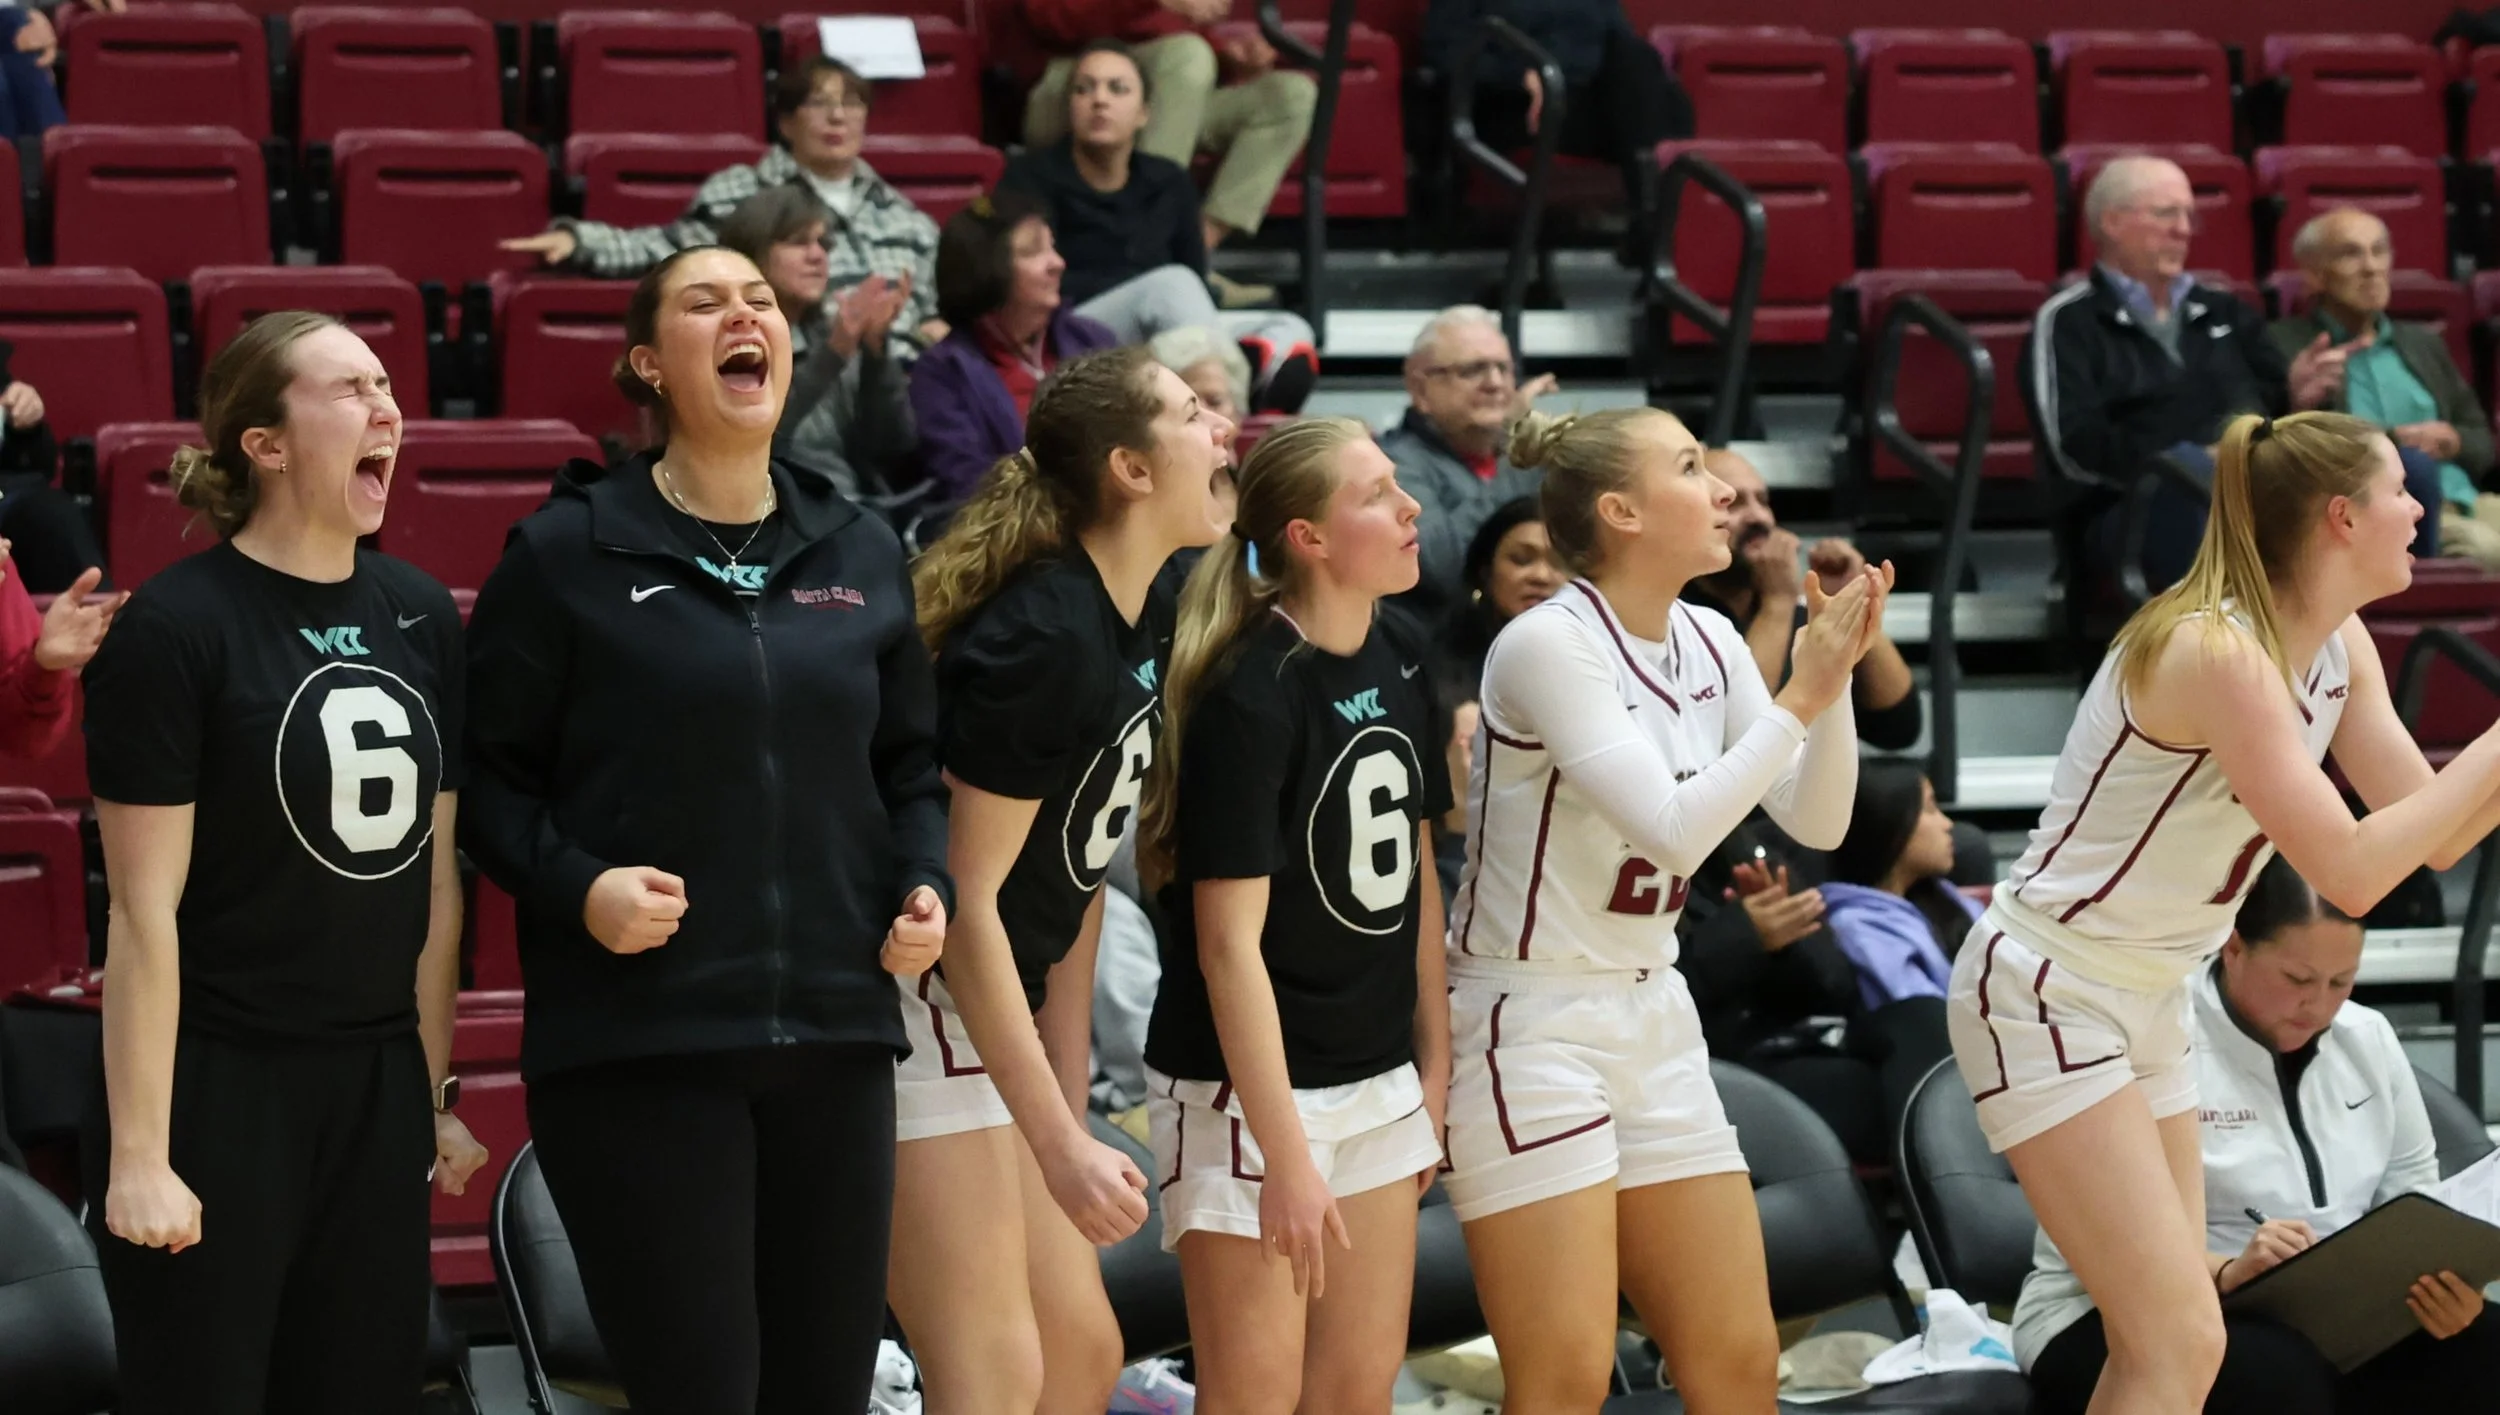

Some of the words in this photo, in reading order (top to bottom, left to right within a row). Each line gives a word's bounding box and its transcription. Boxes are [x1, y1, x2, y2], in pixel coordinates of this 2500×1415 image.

[696, 556, 769, 589] WCC
[300, 627, 371, 656] WCC
[1334, 687, 1387, 725] WCC
[1689, 684, 1718, 703] WCC
[319, 686, 418, 853] 6
[1085, 718, 1152, 870] 6
[1348, 749, 1412, 912] 6
[2224, 1109, 2258, 1123] CLARA
